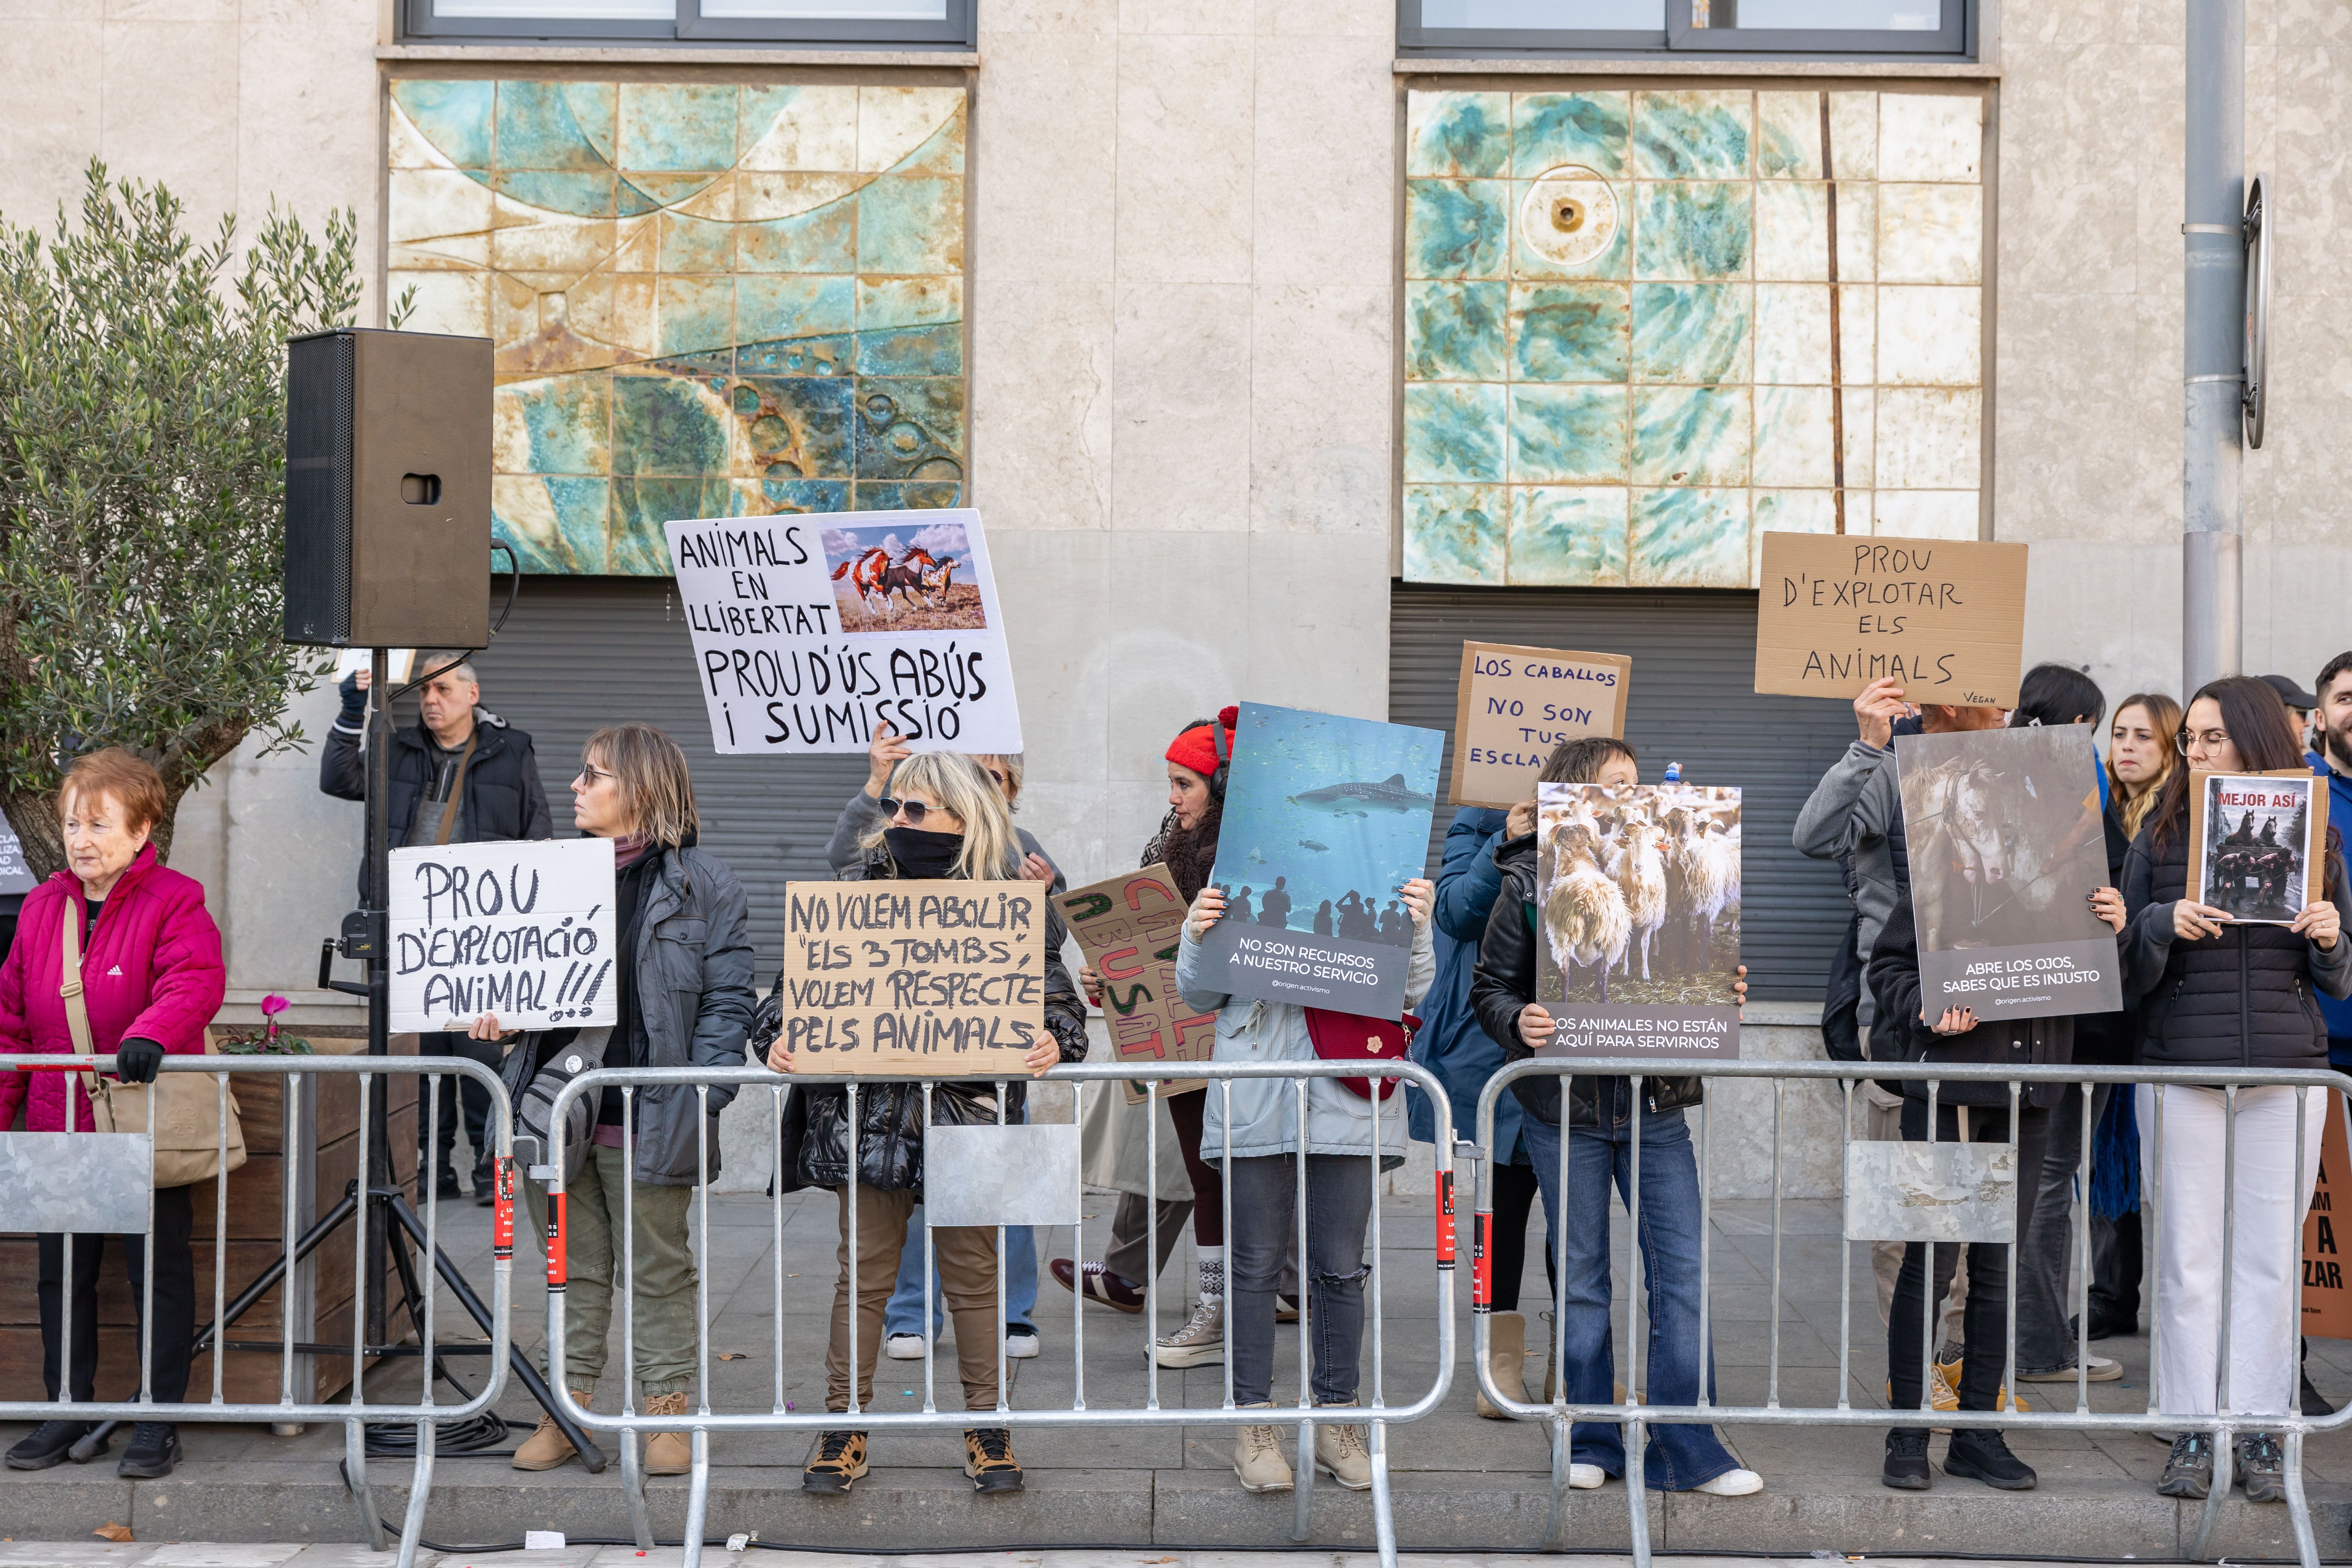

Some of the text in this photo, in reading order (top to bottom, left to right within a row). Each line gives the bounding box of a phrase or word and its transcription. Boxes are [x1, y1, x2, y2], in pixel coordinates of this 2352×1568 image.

[1855, 545, 1931, 575] PROU
[733, 571, 769, 600] EN
[1783, 573, 1963, 609] D'EXPLOTAR
[1859, 615, 1907, 633] ELS
[704, 641, 987, 702] PROU D'ÚS ABÚS
[1474, 655, 1617, 686] LOS CABALLOS
[1487, 697, 1592, 726] NO SON
[1519, 728, 1567, 746] TUS
[2218, 793, 2296, 808] MEJOR ASÍ
[416, 862, 539, 929] PROU
[791, 892, 829, 933] NO
[837, 892, 911, 931] VOLEM
[861, 940, 890, 967] 3
[1239, 938, 1374, 969] NO SON RECURSOS
[1965, 956, 2075, 975] ABRE LOS OJOS,
[1229, 952, 1378, 985] A NUESTRO SERVICIO
[1943, 970, 2100, 993] SABES QUE ES INJUSTO
[789, 970, 1044, 1010] VOLEM RESPECTE
[1272, 980, 1330, 995] @origen.activismo
[1995, 995, 2051, 1005] @origen.activismo
[787, 1016, 859, 1053] PELS
[1555, 1031, 1719, 1049] AQUÍ PARA SERVIRNOS
[1579, 1018, 1653, 1032] ANIMALES
[1657, 1019, 1679, 1032] NO
[1683, 1018, 1727, 1033] ESTÁN
